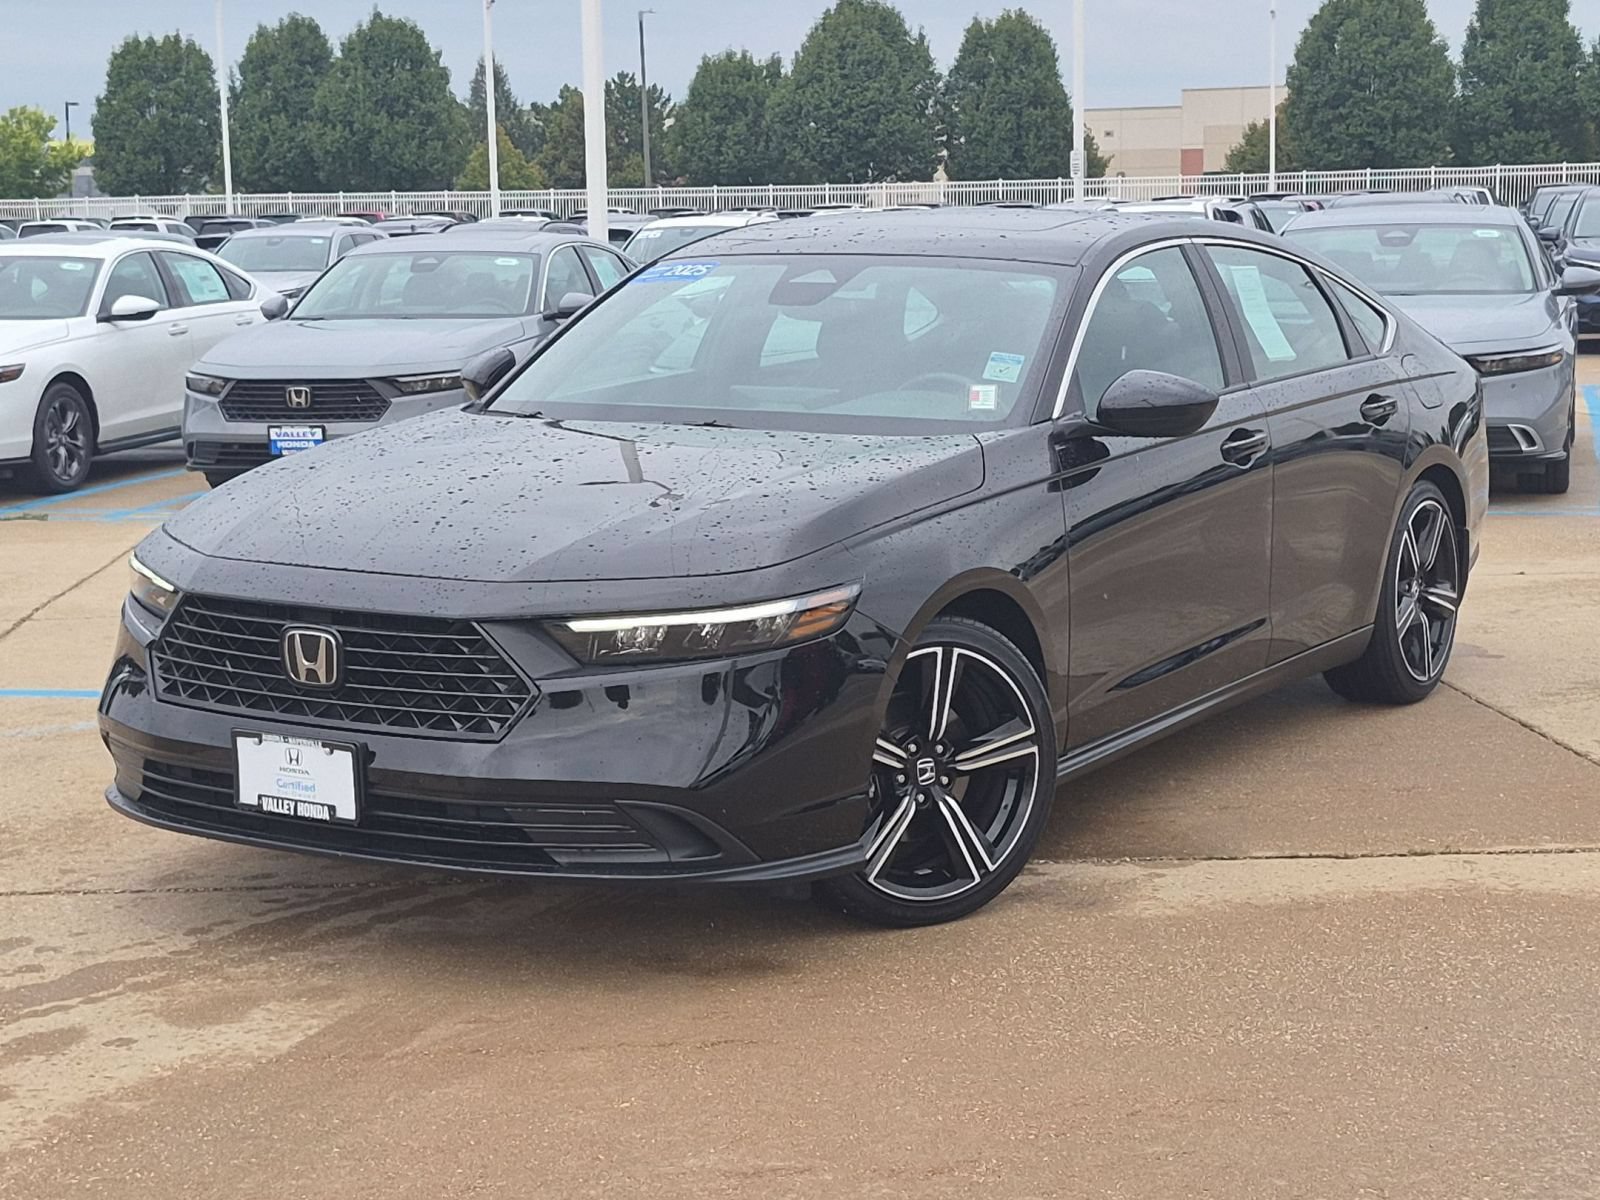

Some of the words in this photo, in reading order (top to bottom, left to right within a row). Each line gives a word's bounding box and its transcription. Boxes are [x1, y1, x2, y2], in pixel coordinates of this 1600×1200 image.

[276, 440, 315, 449] HONDA
[279, 767, 310, 776] HONDA
[276, 778, 316, 793] Certified
[261, 796, 296, 816] VALLEY
[297, 801, 330, 821] HONDA
